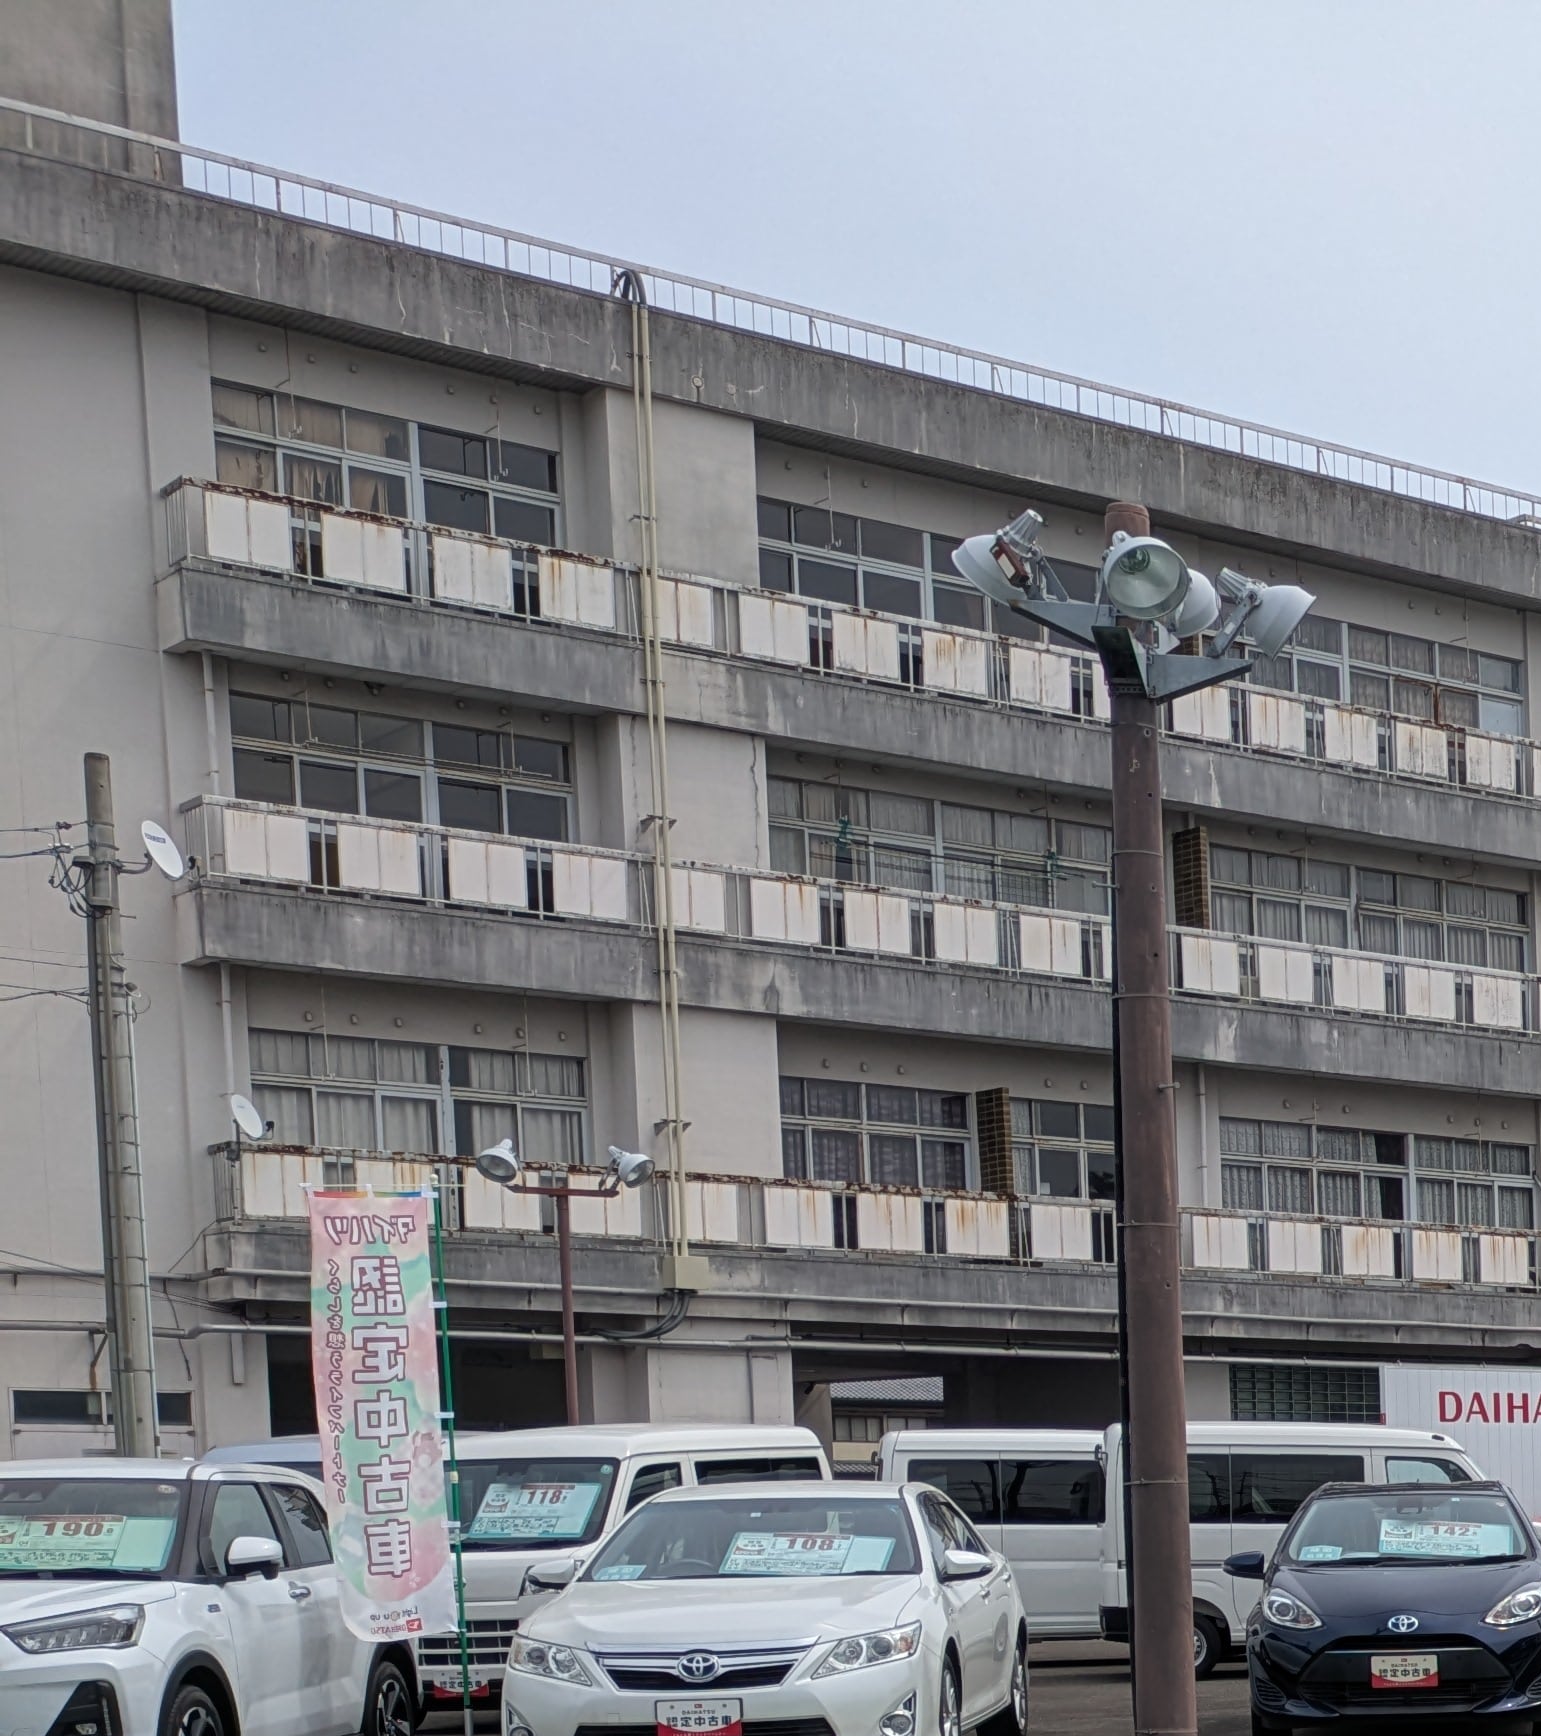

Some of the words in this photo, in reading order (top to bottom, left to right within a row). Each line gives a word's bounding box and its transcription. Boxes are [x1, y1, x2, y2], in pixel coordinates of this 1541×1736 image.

[527, 1490, 561, 1504] 118
[43, 1522, 104, 1537] 190
[1431, 1523, 1471, 1537] 142
[786, 1538, 835, 1551] 108
[666, 1716, 731, 1728] 認定中古車
